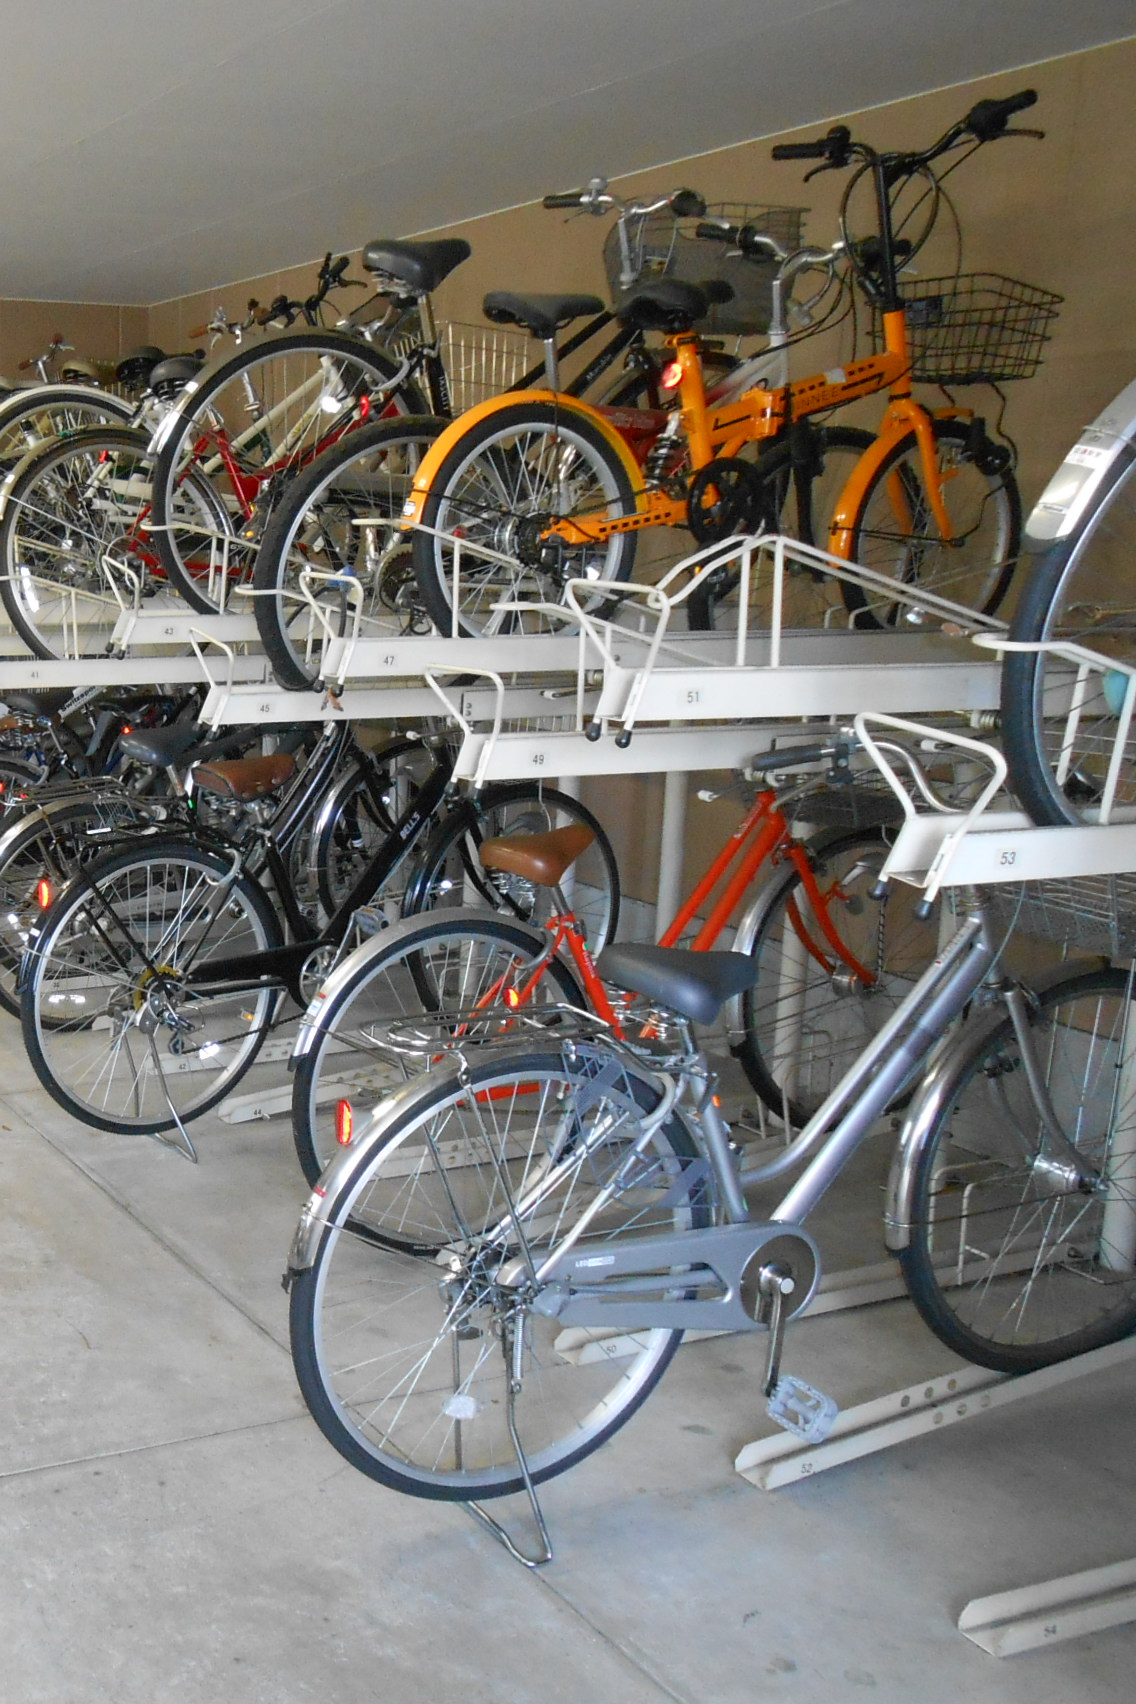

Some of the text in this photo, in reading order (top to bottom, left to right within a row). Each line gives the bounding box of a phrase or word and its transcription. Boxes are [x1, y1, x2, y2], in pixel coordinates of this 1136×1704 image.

[164, 627, 174, 635] 43
[383, 655, 395, 666] 47
[30, 671, 39, 679] 41
[686, 690, 700, 704] 51
[259, 703, 271, 713] 45
[532, 754, 545, 766] 49
[999, 851, 1017, 866] 53
[178, 1063, 187, 1071] 42
[253, 1108, 262, 1116] 44
[606, 1343, 617, 1354] 50
[800, 1463, 813, 1474] 52
